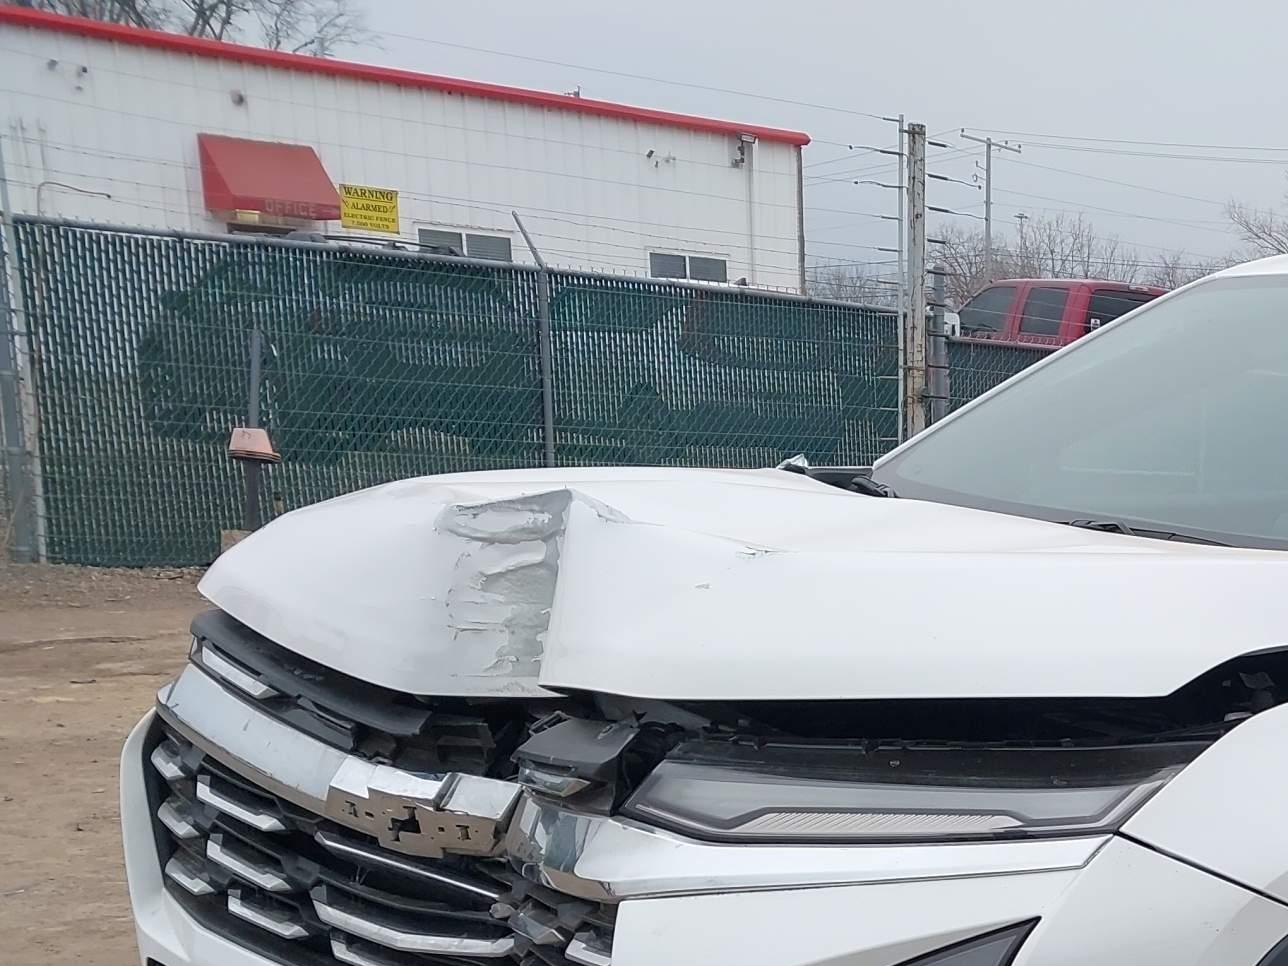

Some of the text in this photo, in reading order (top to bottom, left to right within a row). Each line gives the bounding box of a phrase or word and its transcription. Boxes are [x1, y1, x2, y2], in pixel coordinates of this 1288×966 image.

[343, 186, 393, 201] WARNING
[265, 199, 317, 217] OFFICE
[351, 202, 388, 213] ALARMED
[376, 215, 396, 224] FENCE
